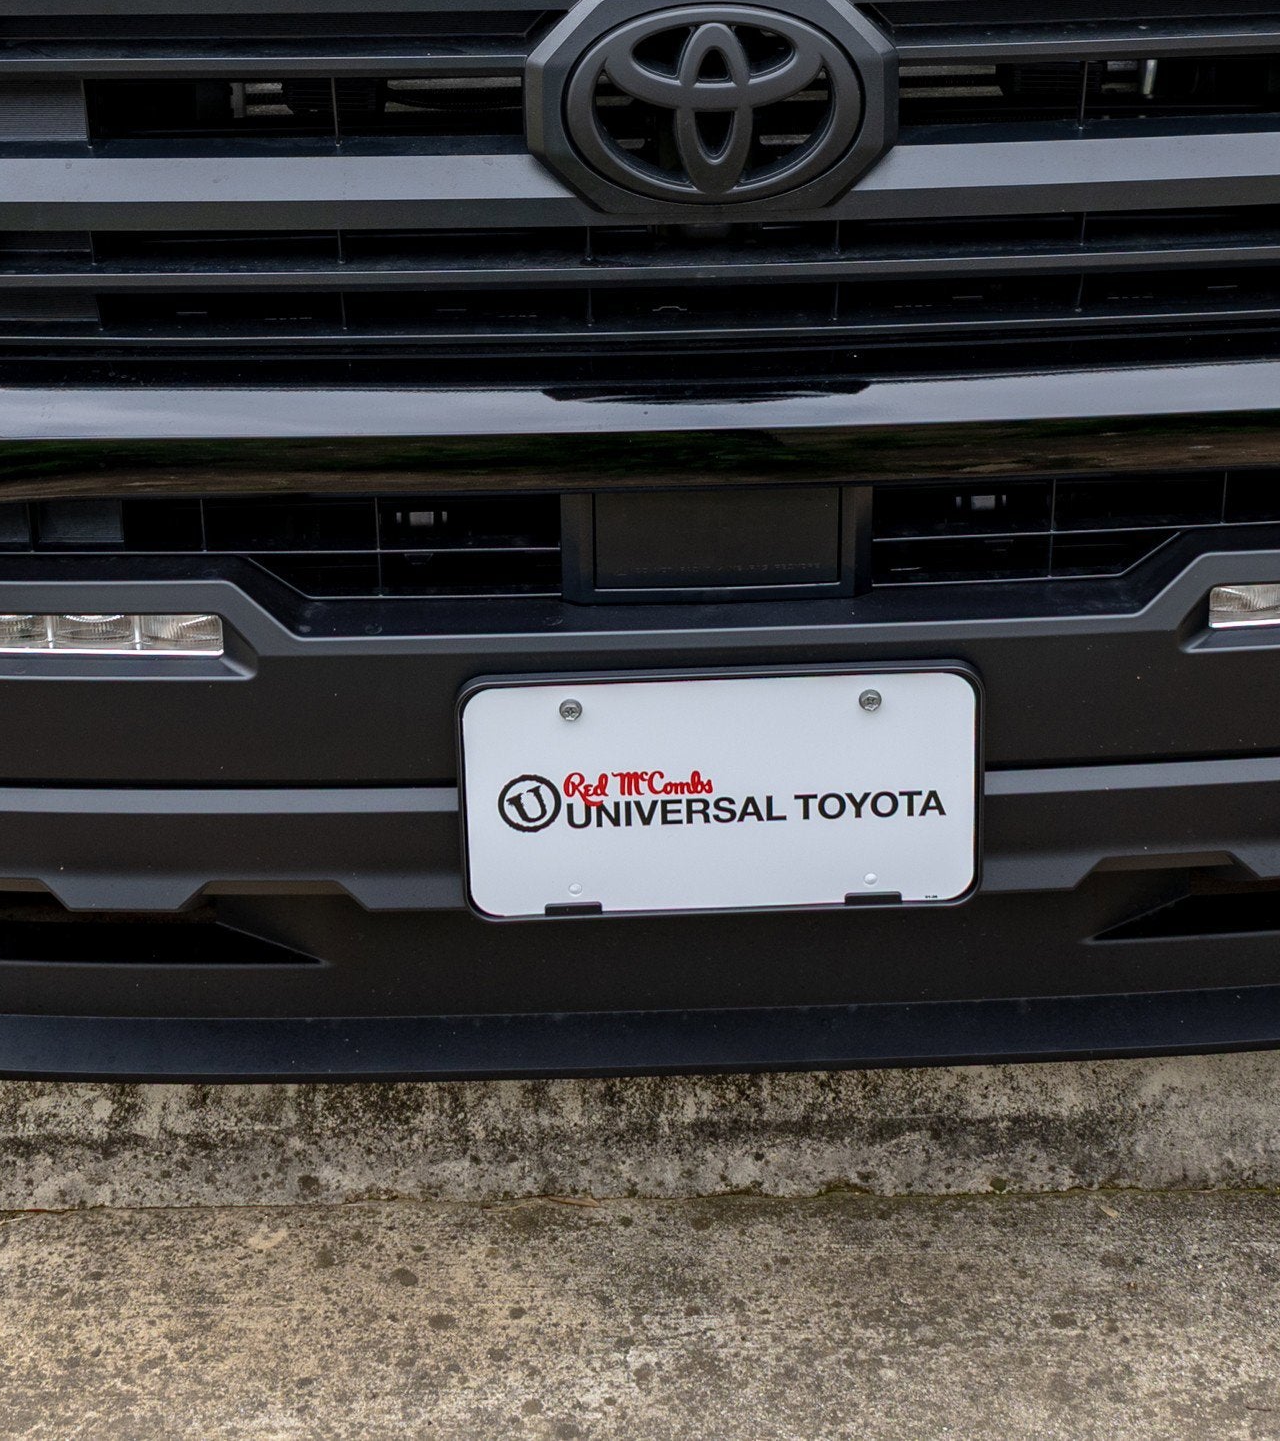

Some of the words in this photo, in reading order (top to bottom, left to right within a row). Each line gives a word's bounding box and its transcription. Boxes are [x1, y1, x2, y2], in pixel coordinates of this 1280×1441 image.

[563, 771, 609, 807] Red
[611, 770, 714, 796] McCombs
[566, 795, 787, 829] UNIVERSAL
[793, 789, 947, 820] TOYOTA
